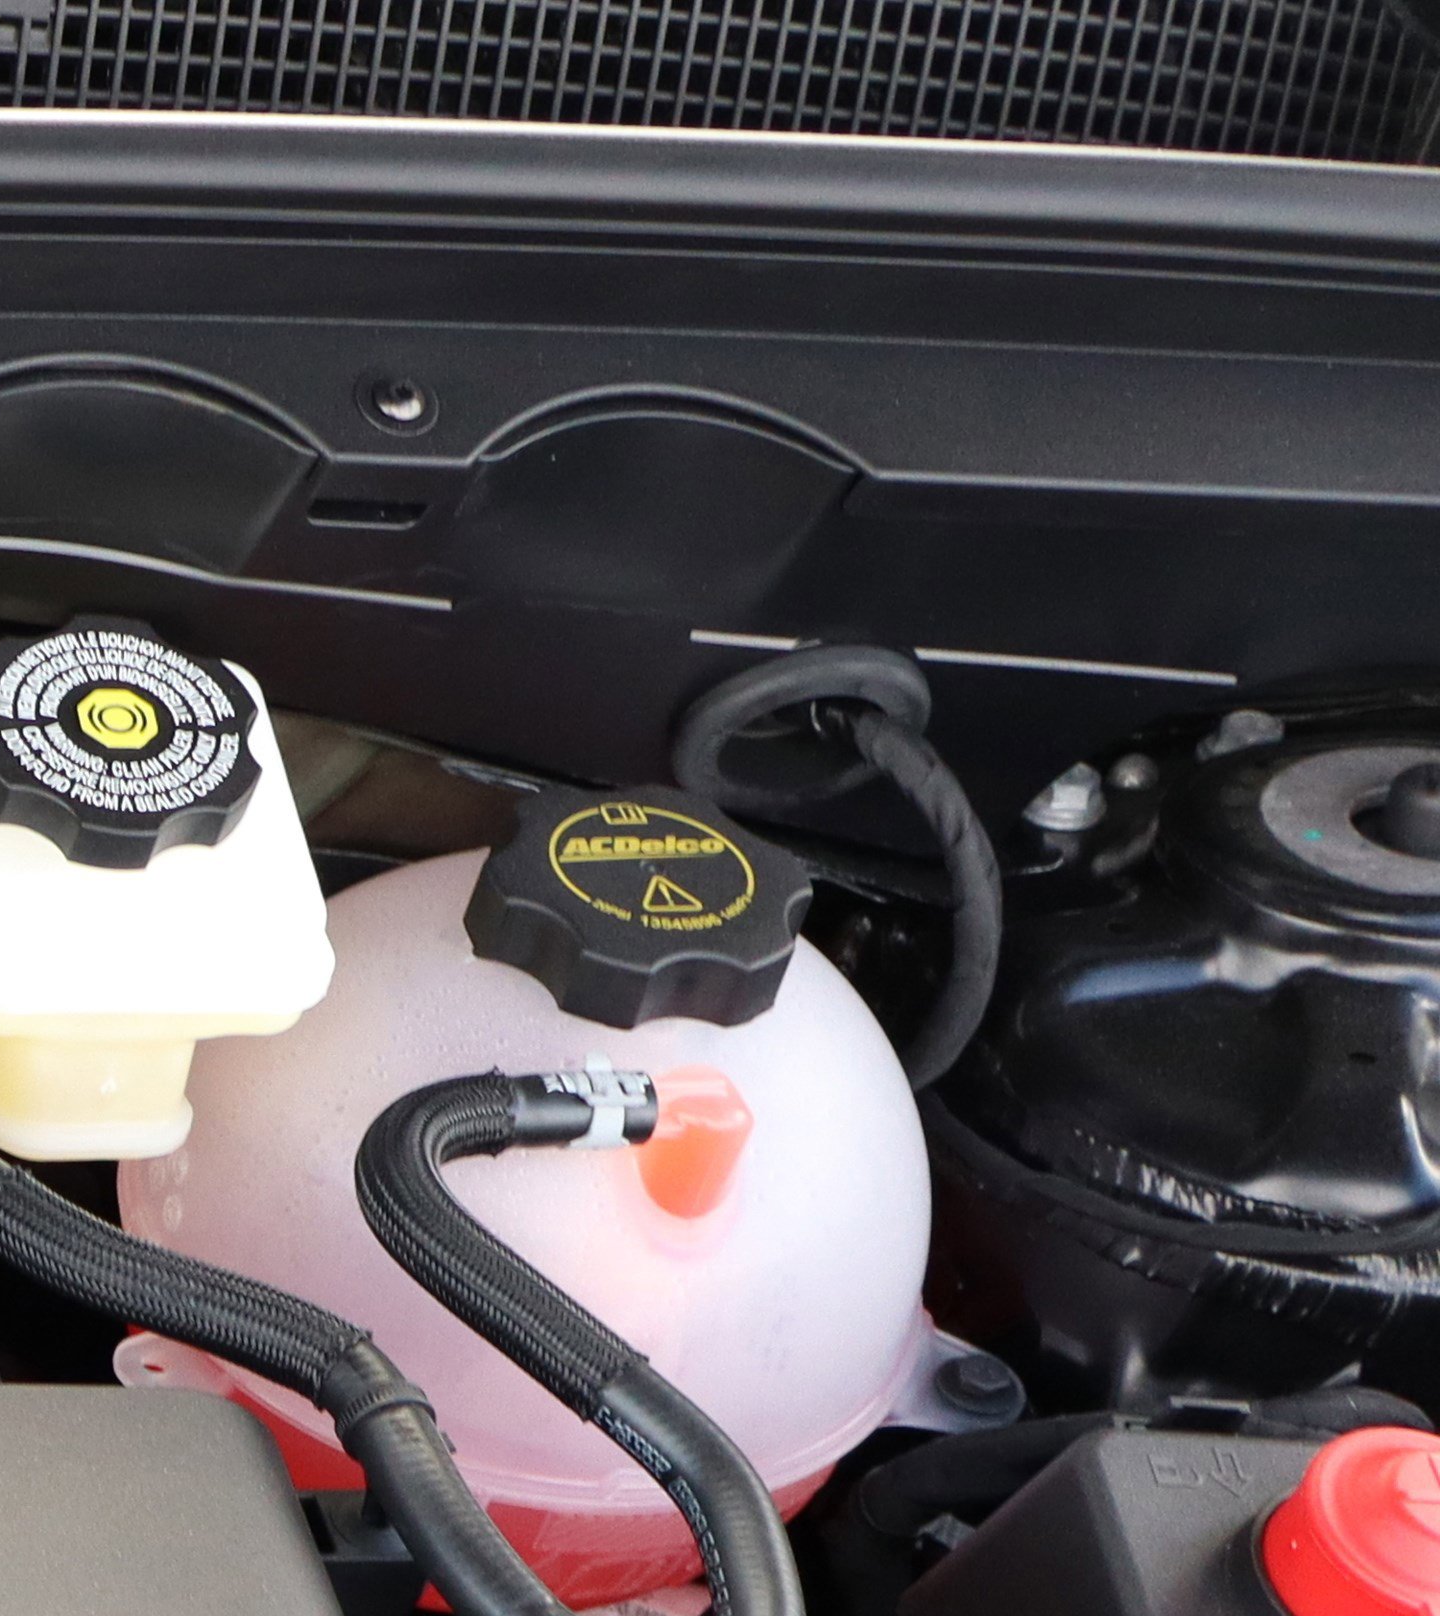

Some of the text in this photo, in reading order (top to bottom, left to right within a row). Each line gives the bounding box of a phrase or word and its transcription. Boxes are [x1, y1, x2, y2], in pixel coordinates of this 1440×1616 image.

[111, 757, 165, 778] CLEAN
[70, 783, 119, 811] FROM
[121, 795, 134, 813] A
[560, 834, 726, 860] ACDelco
